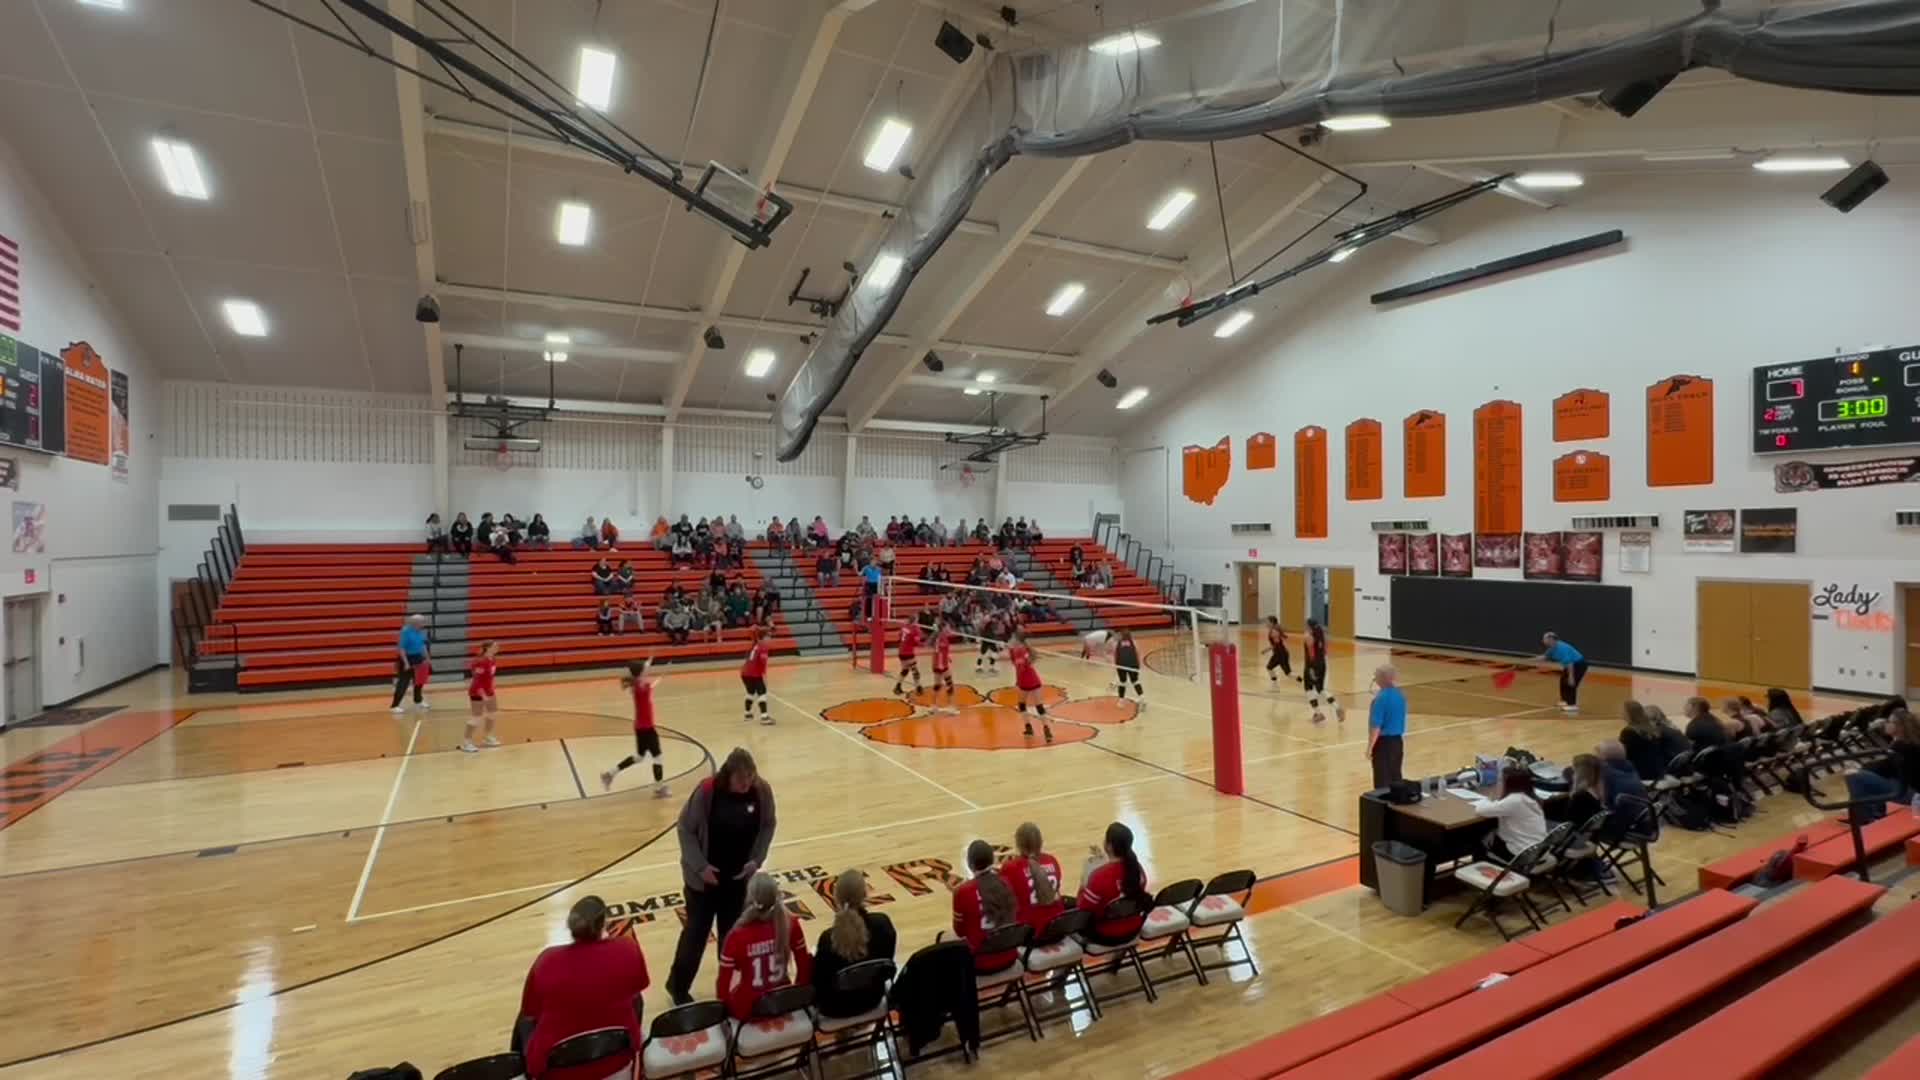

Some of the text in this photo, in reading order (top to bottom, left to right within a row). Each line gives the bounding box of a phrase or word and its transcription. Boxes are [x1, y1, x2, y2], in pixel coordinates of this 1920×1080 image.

[1835, 353, 1870, 363] PERIOD
[1767, 366, 1804, 379] HOME
[1839, 377, 1864, 386] POSS
[1835, 385, 1869, 394] BONUS
[1837, 398, 1884, 418] 3:00
[1818, 421, 1888, 433] PLAYER FOUL
[1775, 435, 1788, 447] 0
[1813, 583, 1880, 615] Lady
[751, 954, 786, 988] 15
